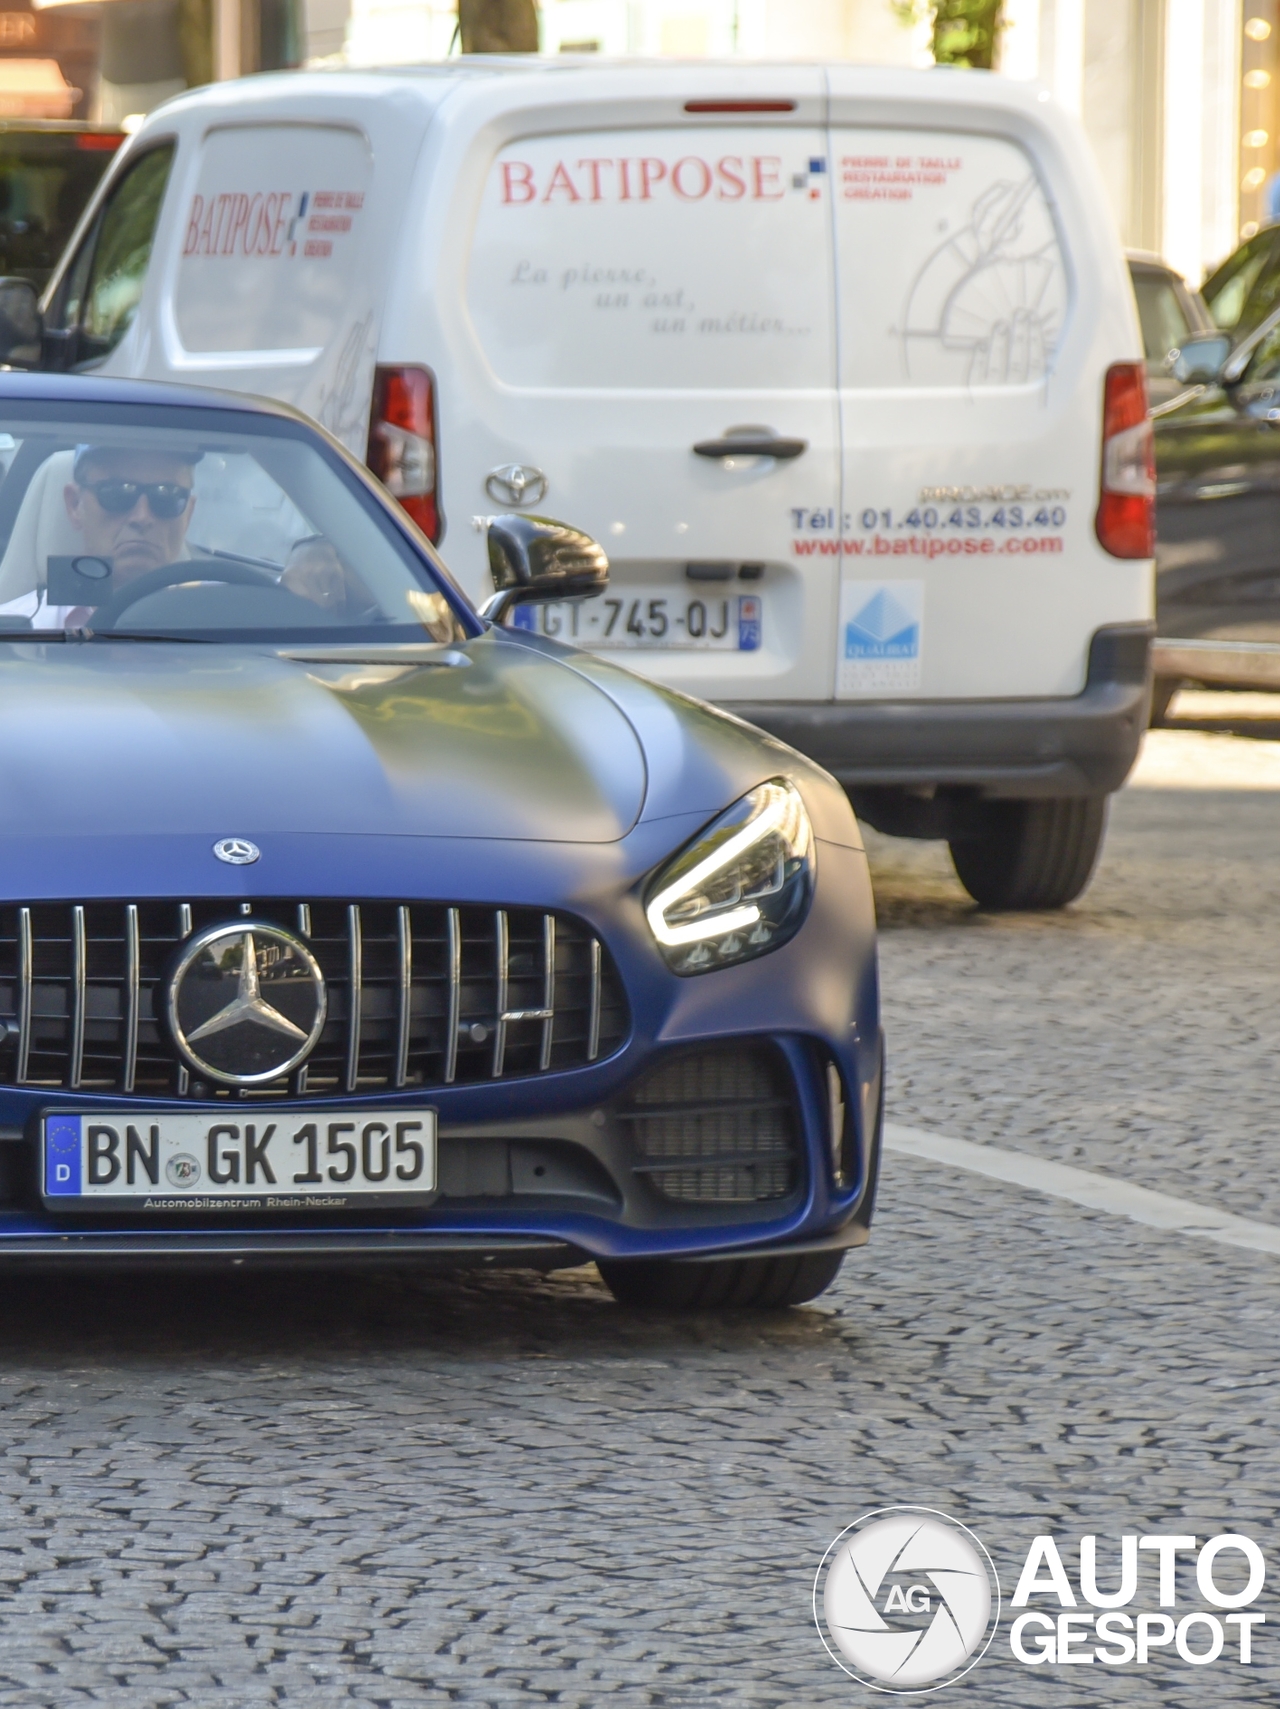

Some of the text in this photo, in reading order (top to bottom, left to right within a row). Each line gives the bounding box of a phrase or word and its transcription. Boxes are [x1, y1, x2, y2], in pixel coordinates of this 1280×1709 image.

[499, 155, 786, 205] BATIPOSE
[183, 191, 293, 257] BATIPOSE
[792, 507, 835, 530] Tél
[861, 505, 1066, 530] 01.40.43.43.40
[793, 530, 1063, 559] www.batipose.com
[88, 1124, 159, 1185] BN
[208, 1123, 277, 1184] GK
[293, 1120, 424, 1183] 1505
[56, 1164, 70, 1181] D
[144, 1196, 347, 1209] Automobilzentrum Rhein-Neckar
